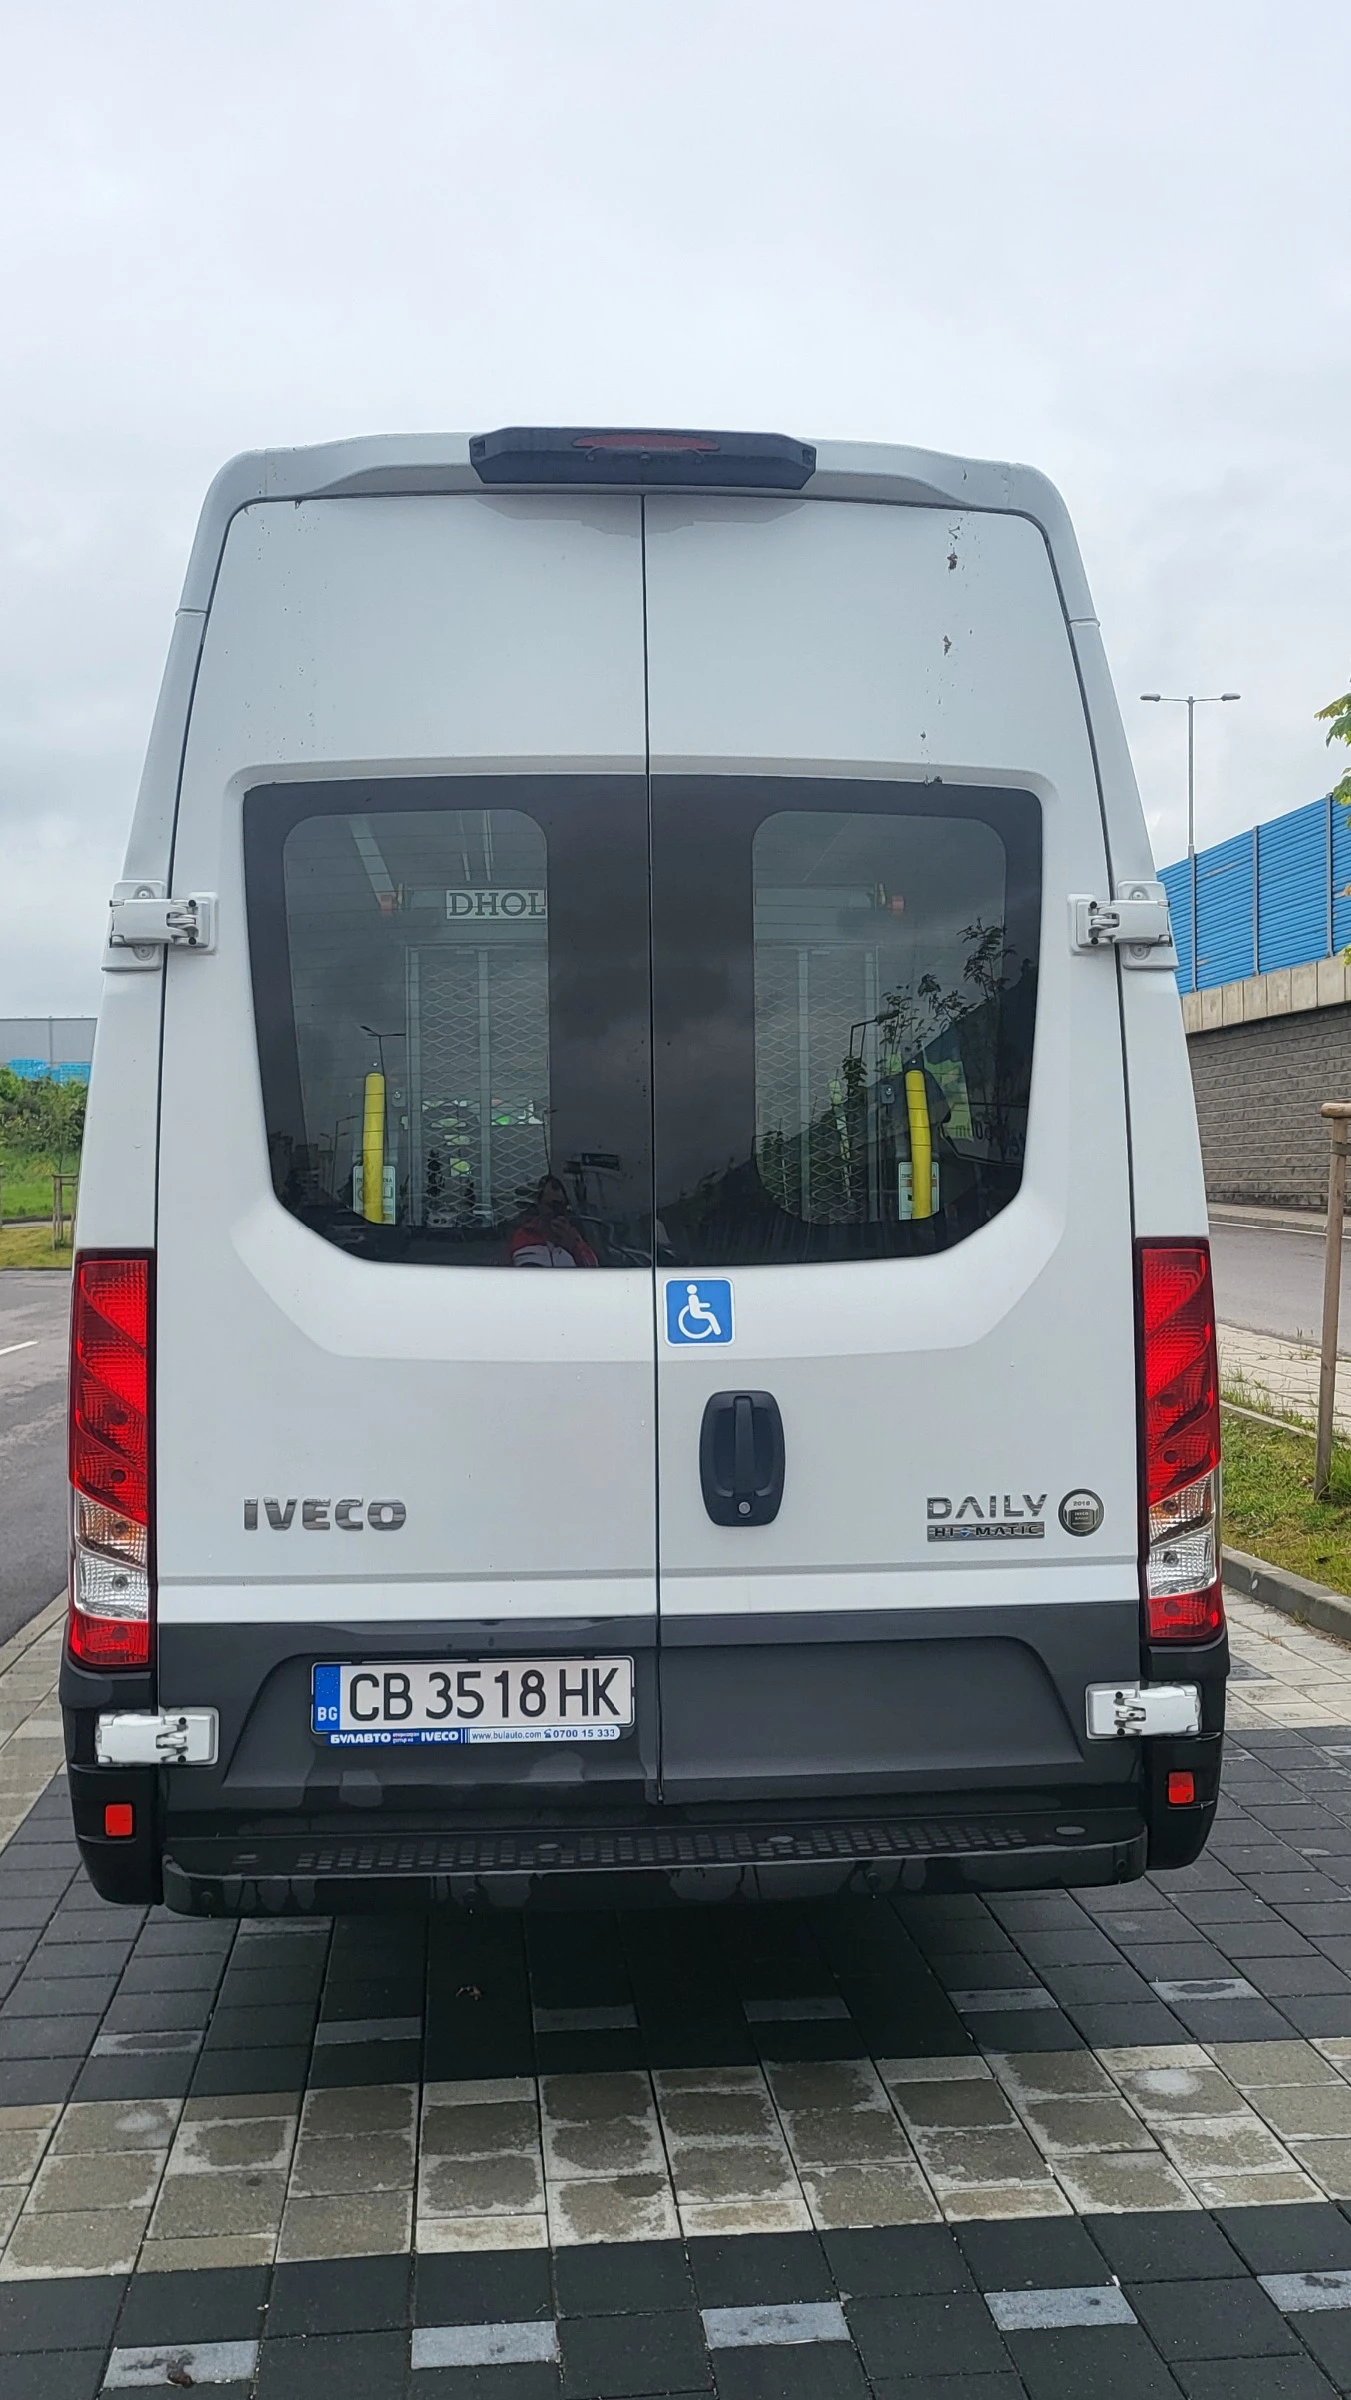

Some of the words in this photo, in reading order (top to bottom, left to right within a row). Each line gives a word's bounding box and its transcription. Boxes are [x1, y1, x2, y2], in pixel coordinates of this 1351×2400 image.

[927, 1494, 1048, 1519] DAILY
[244, 1497, 407, 1531] IVECO
[425, 1669, 547, 1719] 3518
[317, 1707, 338, 1722] BG
[330, 1732, 392, 1744] БУЛАВТО
[420, 1731, 459, 1742] IVECO
[471, 1729, 542, 1741] www.bulauto.com
[552, 1729, 578, 1739] 0700
[581, 1728, 594, 1738] 15
[597, 1728, 615, 1738] 333
